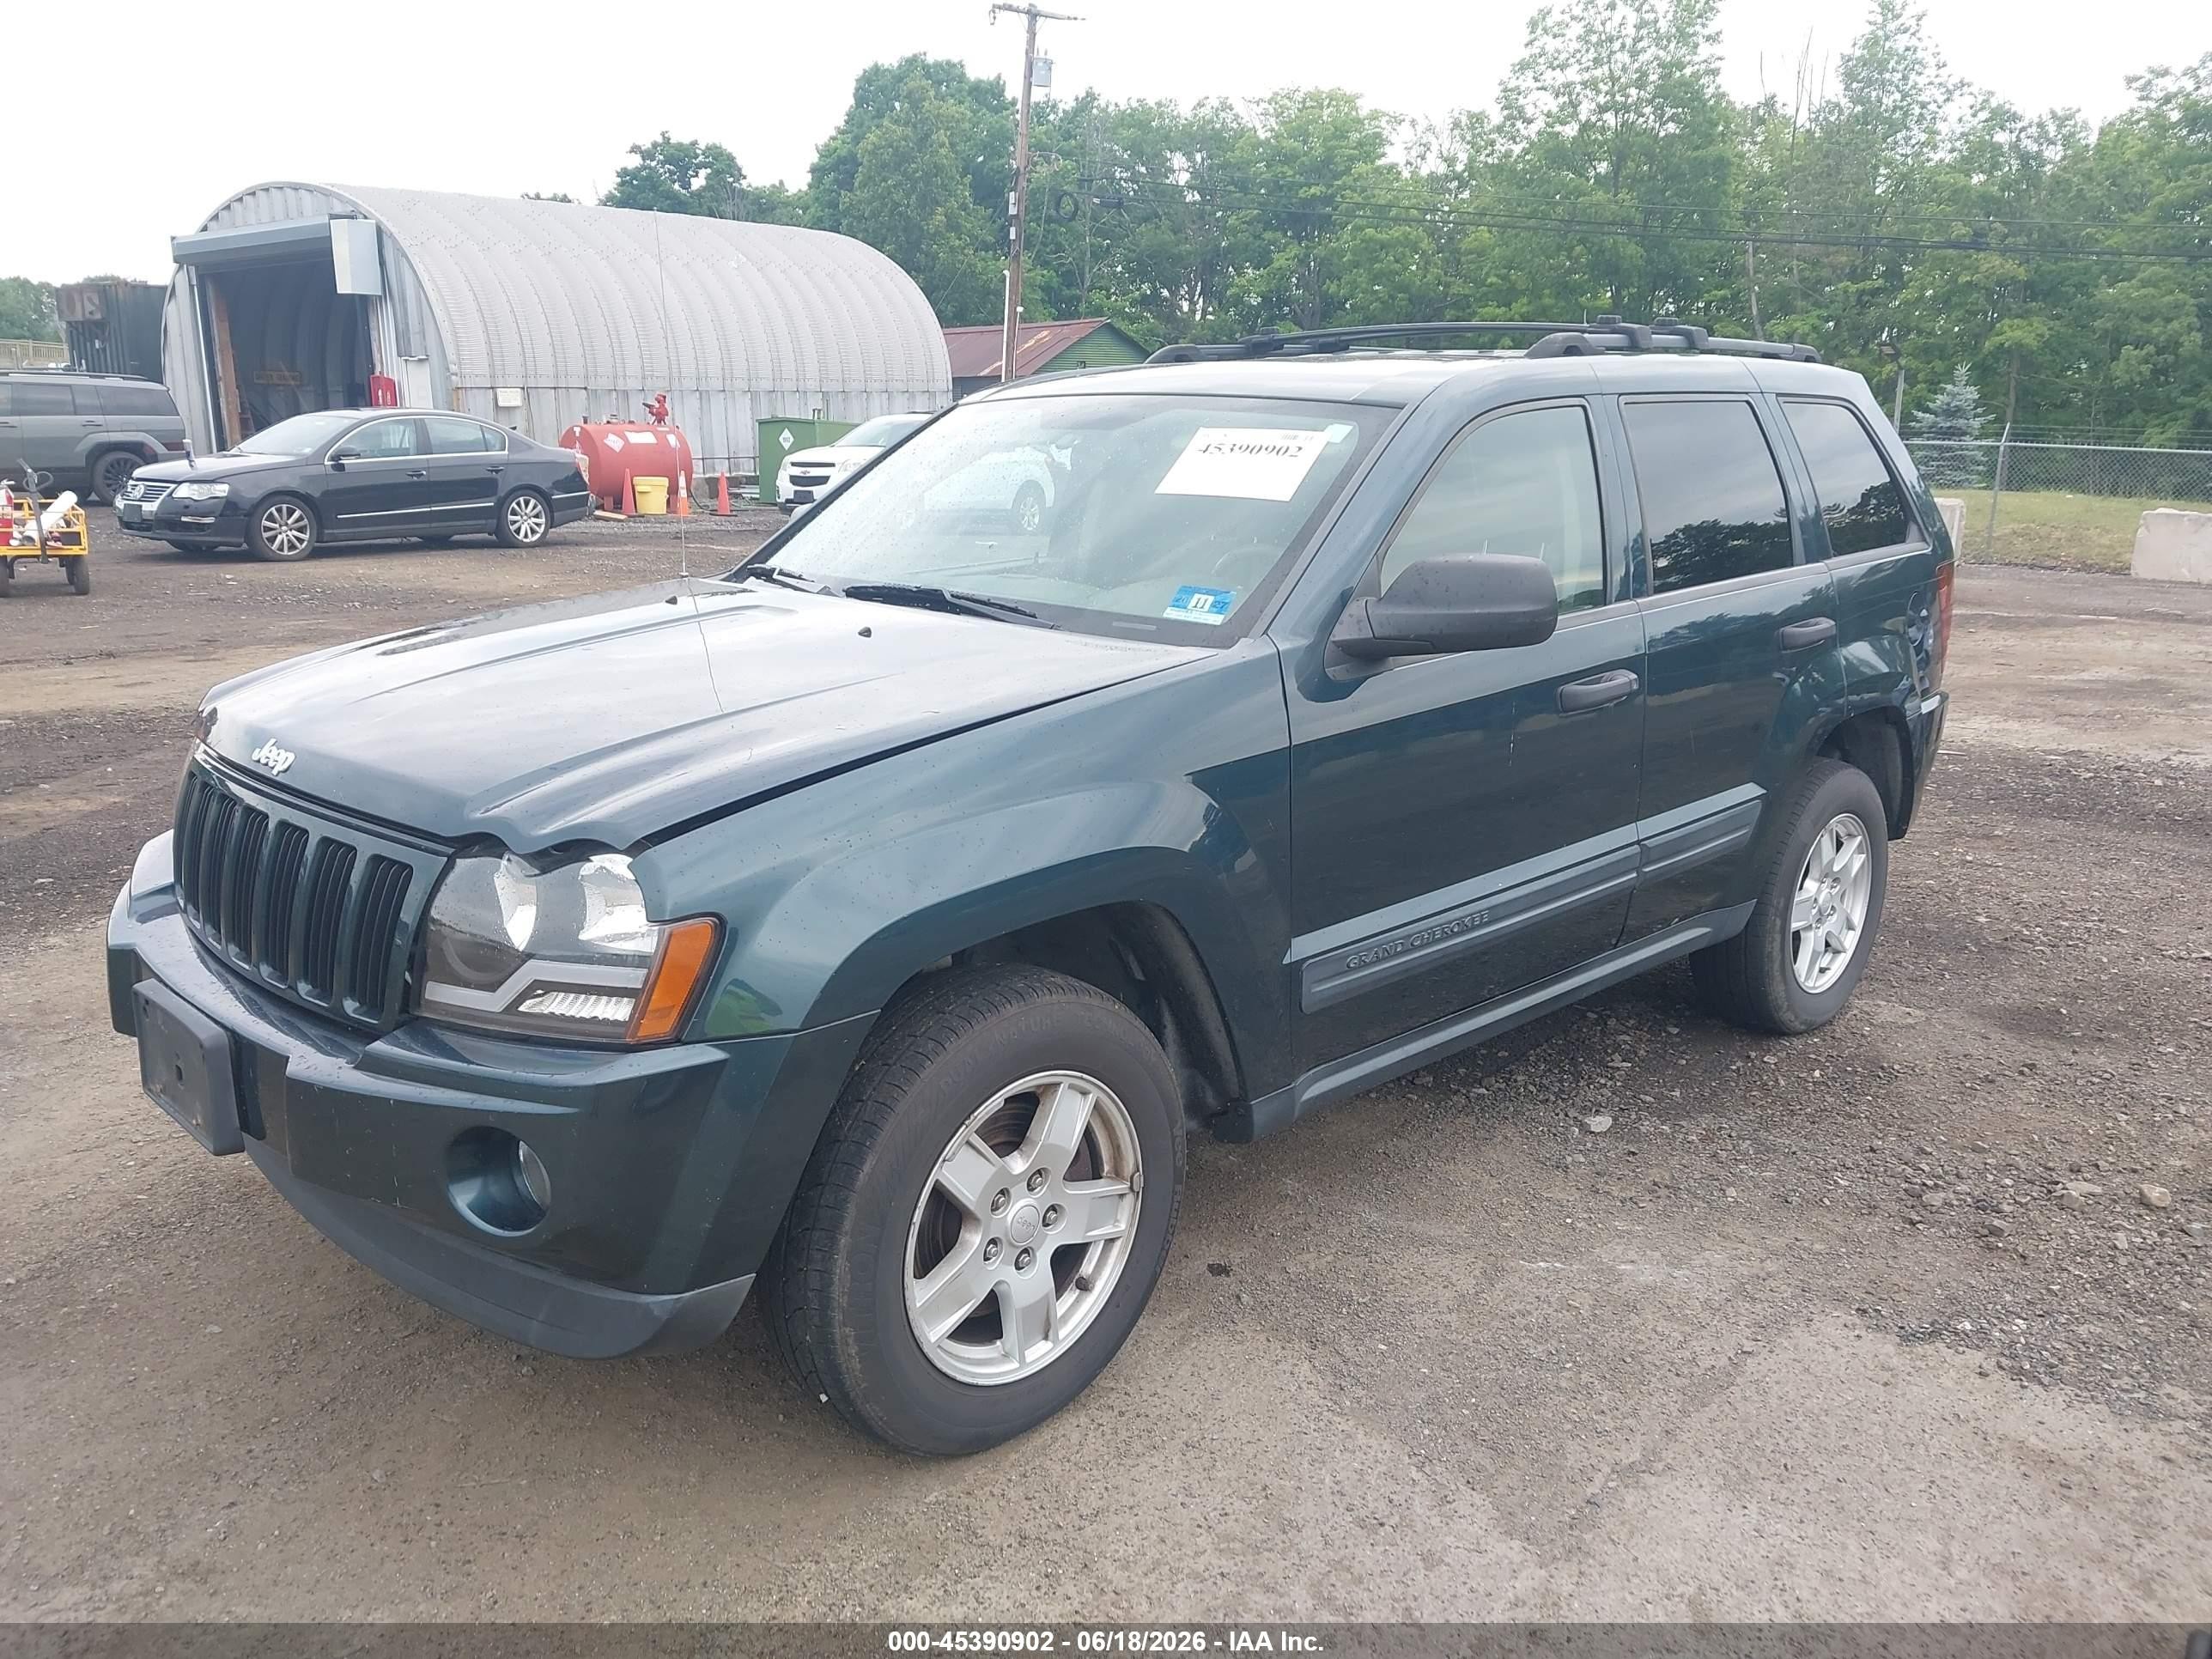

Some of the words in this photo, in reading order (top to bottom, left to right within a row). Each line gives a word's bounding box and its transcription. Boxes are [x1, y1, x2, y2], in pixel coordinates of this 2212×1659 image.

[1197, 442, 1304, 459] 45390902
[1191, 597, 1209, 609] 11
[252, 738, 296, 776] Jeep
[1346, 941, 1406, 969] GRAND
[1409, 910, 1491, 949] CHEROKEE
